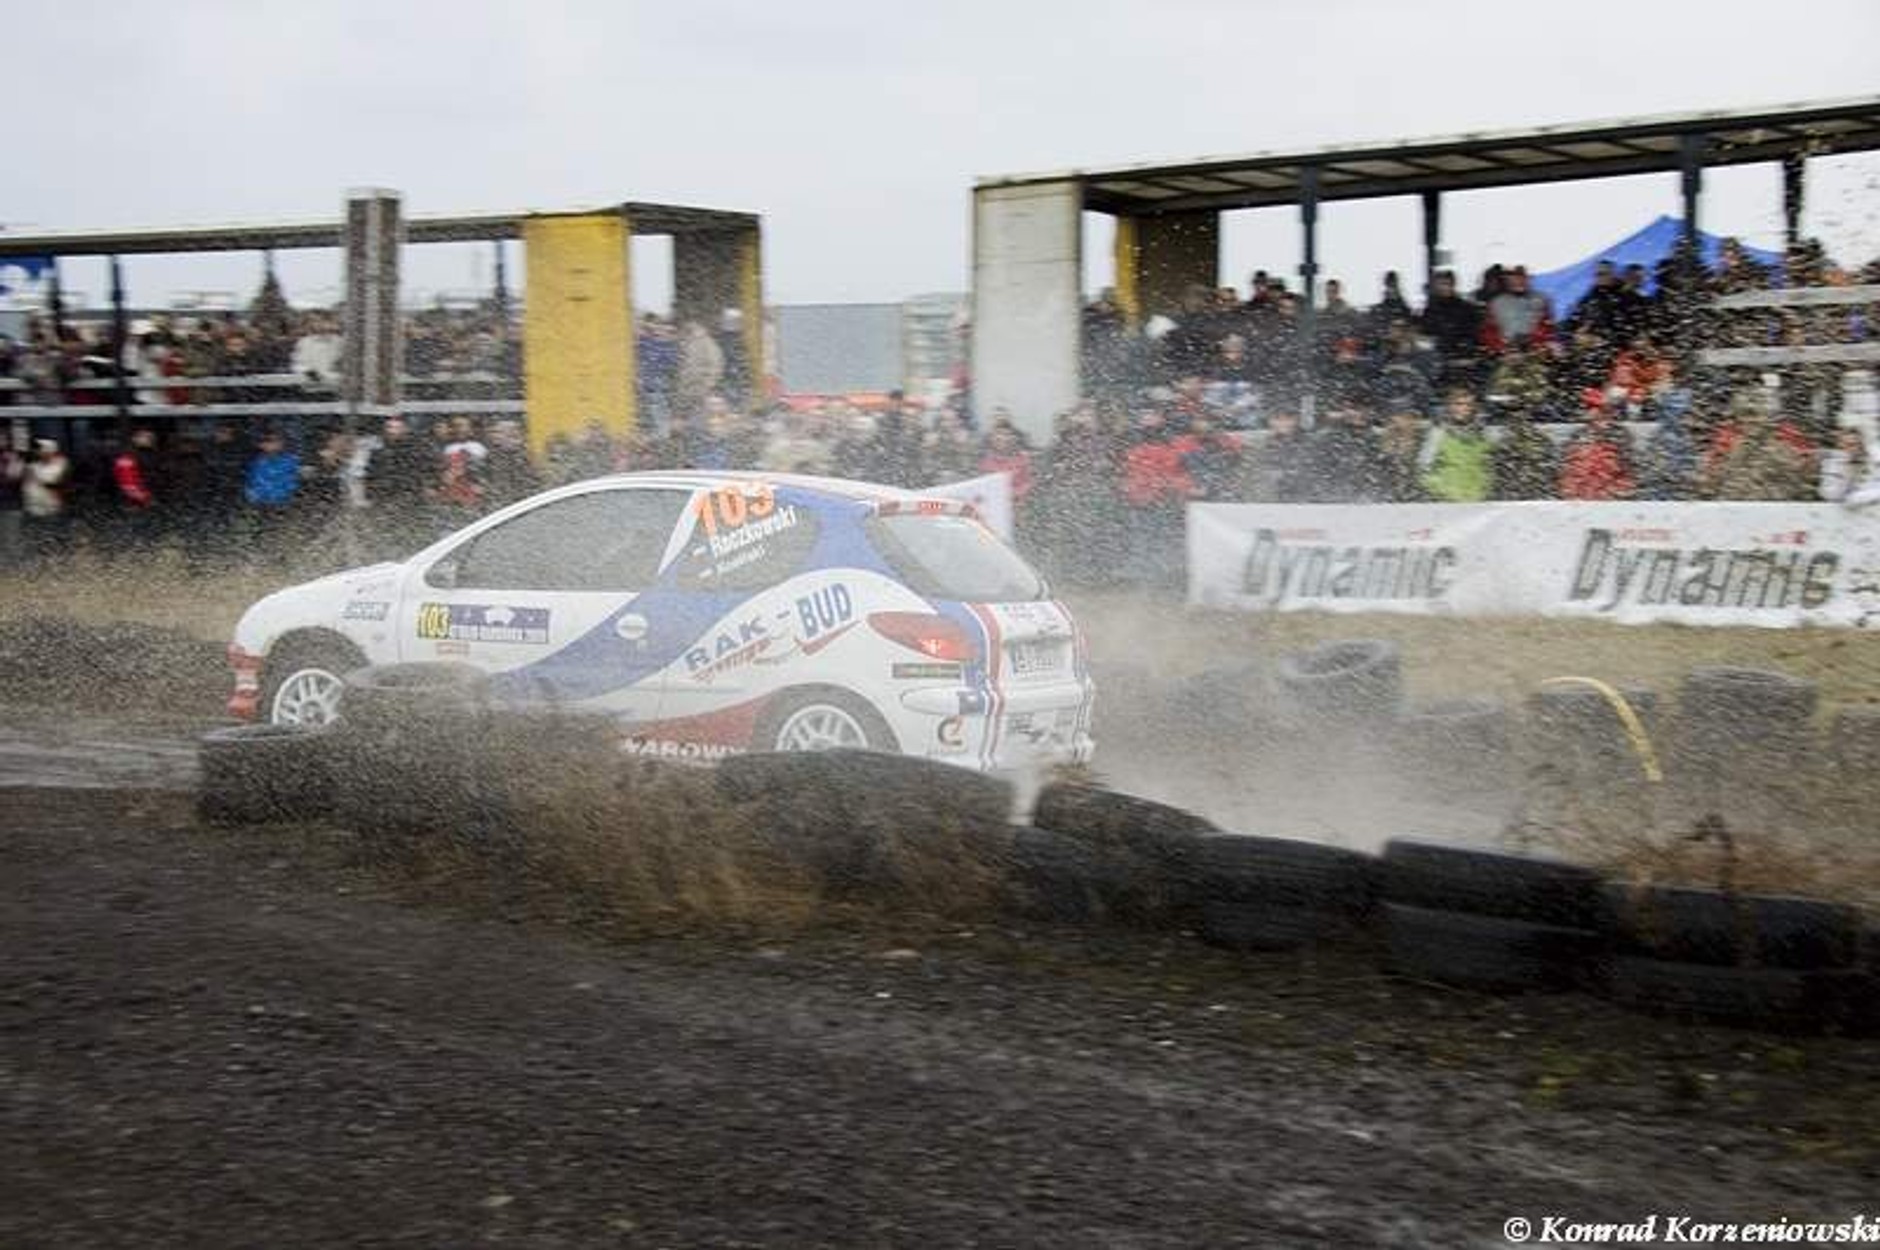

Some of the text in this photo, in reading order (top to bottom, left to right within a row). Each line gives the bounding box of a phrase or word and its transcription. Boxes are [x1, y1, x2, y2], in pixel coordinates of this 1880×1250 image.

[692, 481, 775, 540] 103
[1241, 528, 1456, 605] Dynamic
[1569, 528, 1839, 610] Dynamic
[417, 602, 450, 638] 103
[685, 616, 768, 671] RAK
[796, 582, 852, 638] BUD
